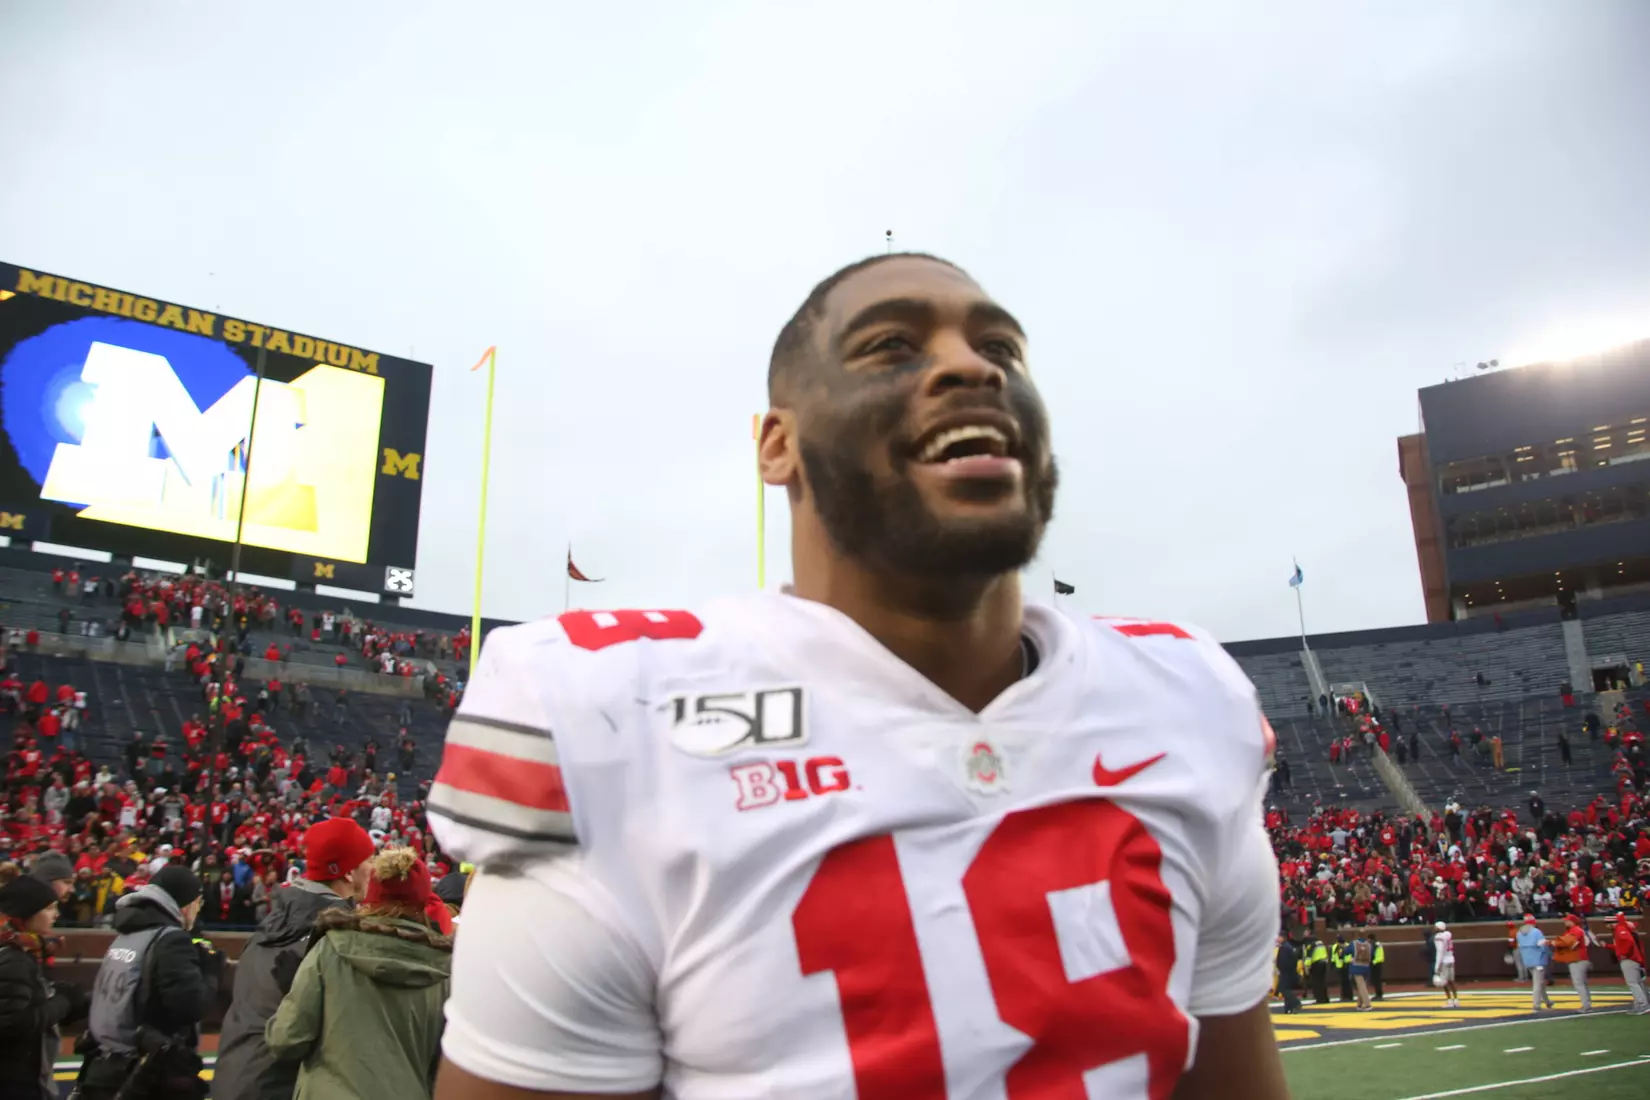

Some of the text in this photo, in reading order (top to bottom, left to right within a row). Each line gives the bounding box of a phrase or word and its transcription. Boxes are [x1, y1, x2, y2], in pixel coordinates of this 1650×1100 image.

[15, 269, 380, 375] MICHIGAN STADIUM
[381, 447, 421, 480] M
[0, 511, 25, 530] M
[314, 561, 335, 579] M
[387, 568, 413, 592] 25
[672, 686, 803, 754] 150
[791, 796, 1191, 1100] 18
